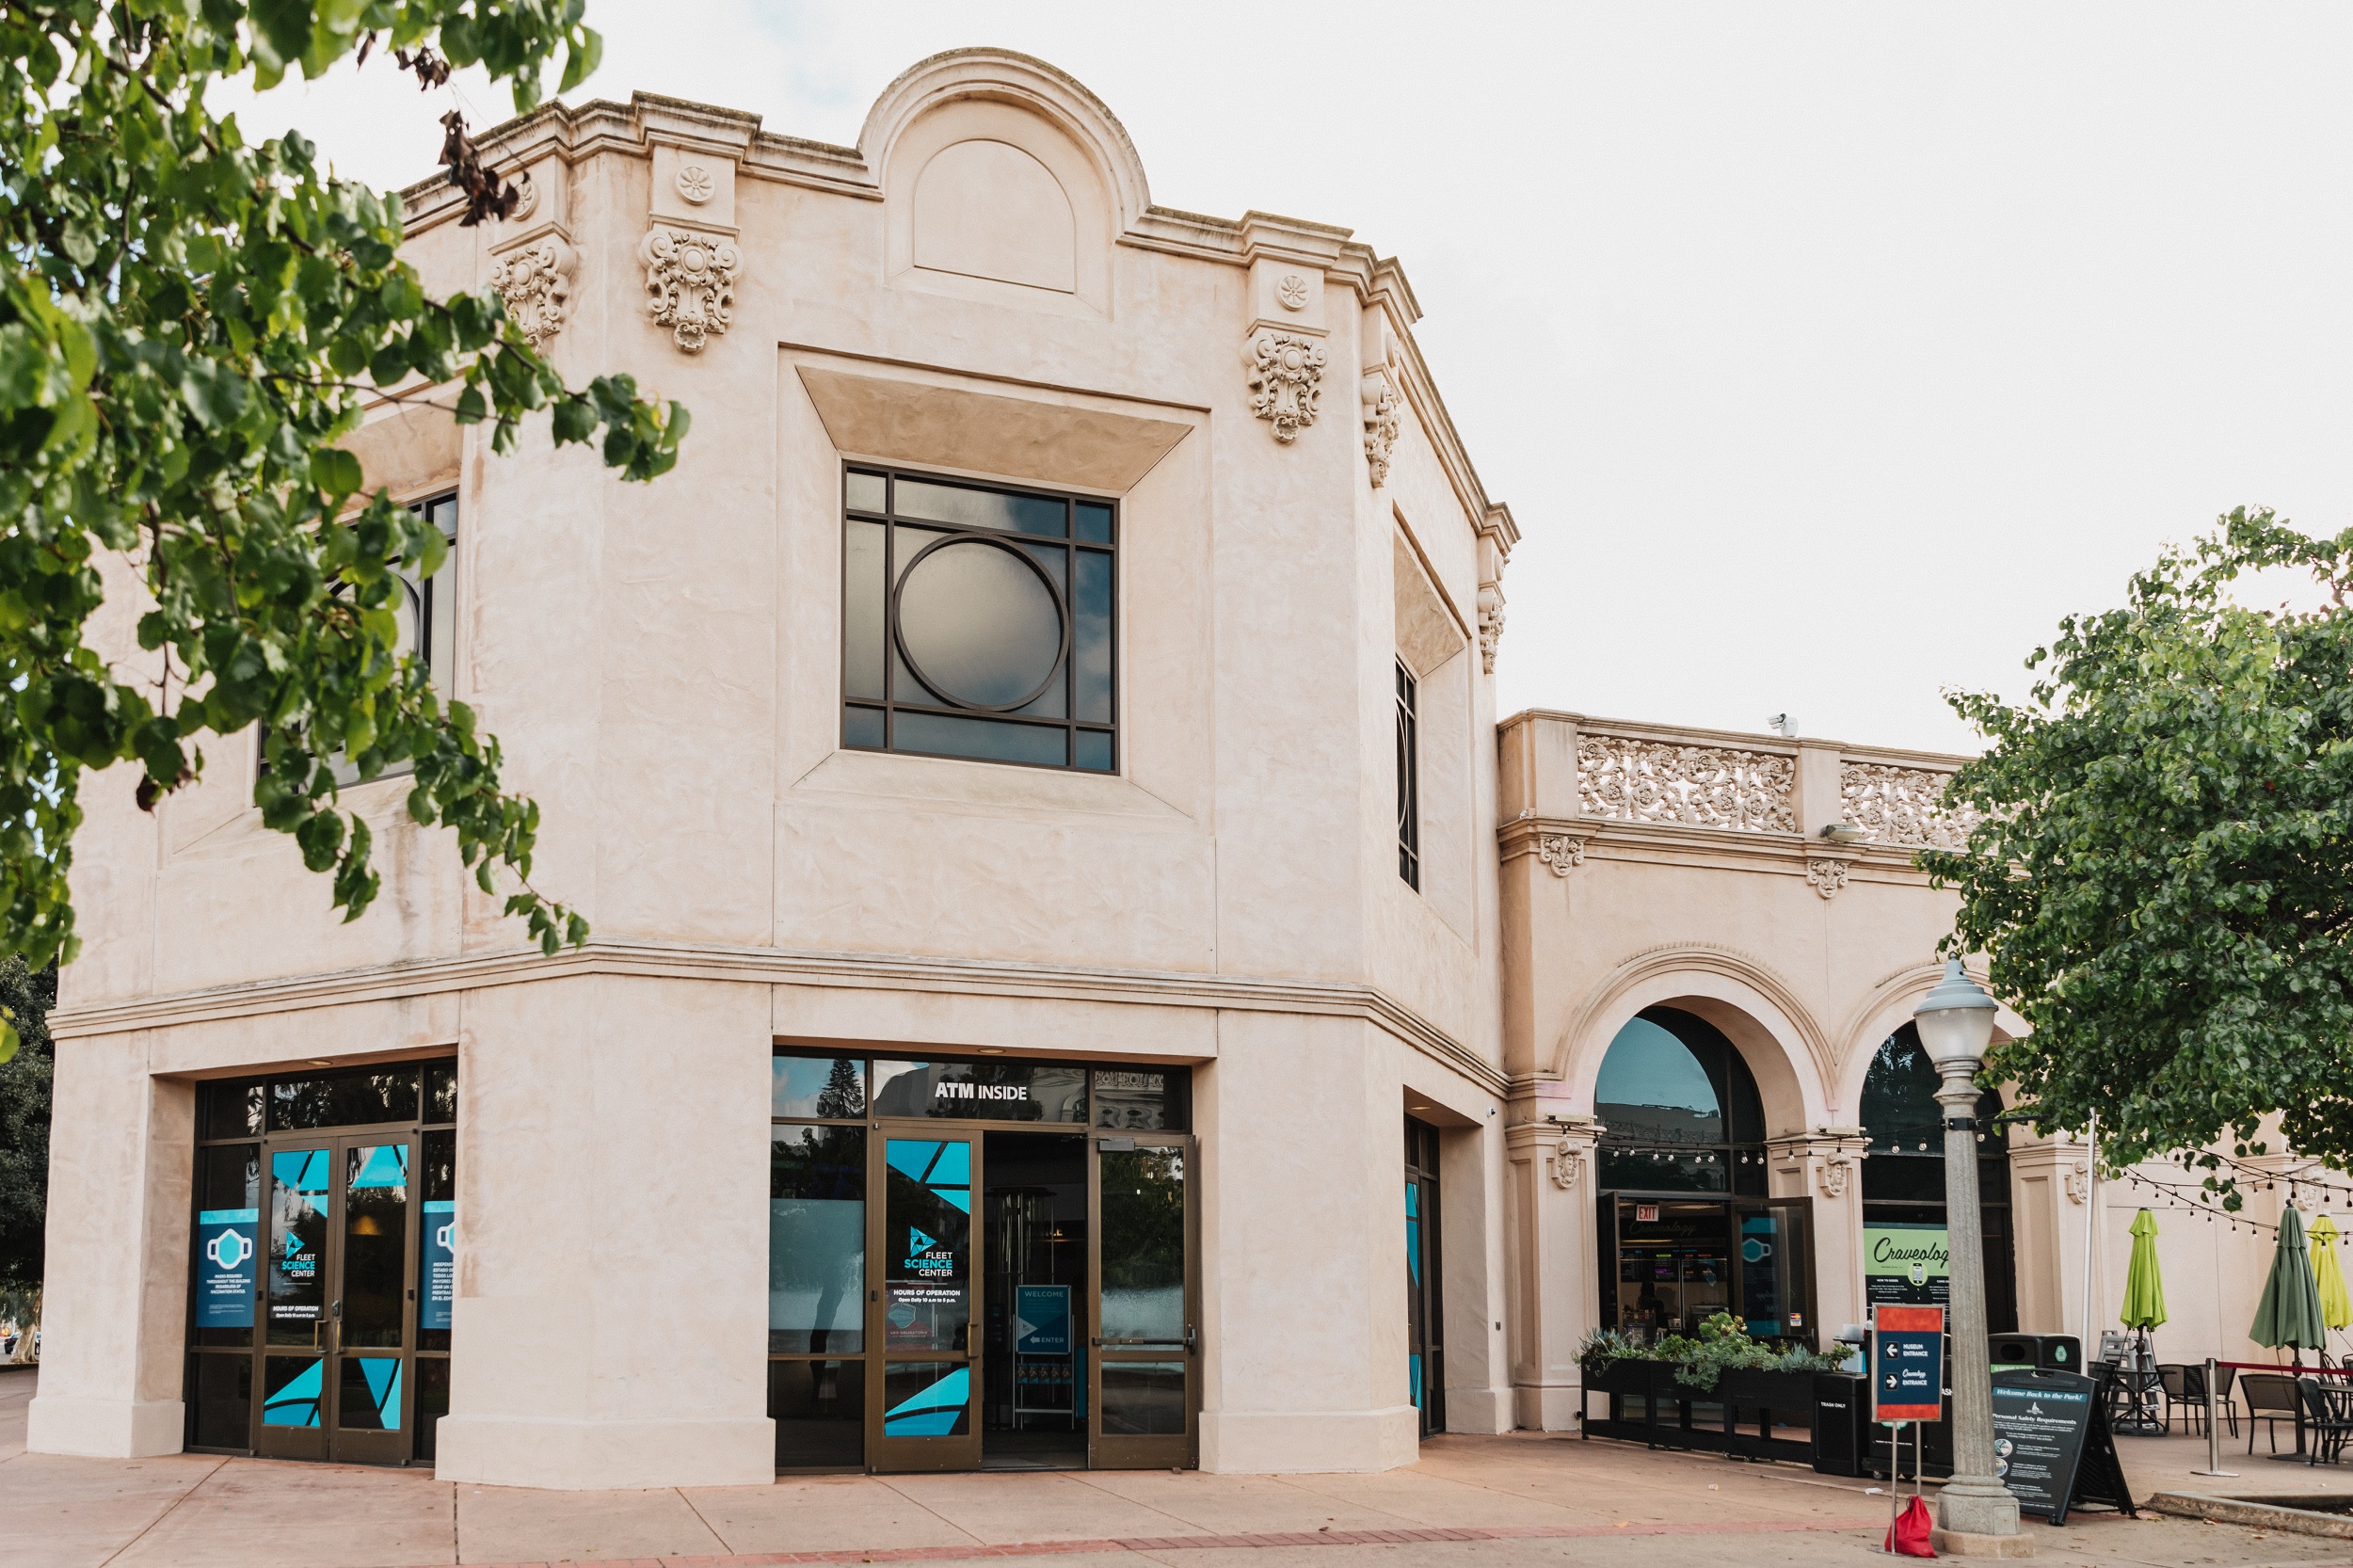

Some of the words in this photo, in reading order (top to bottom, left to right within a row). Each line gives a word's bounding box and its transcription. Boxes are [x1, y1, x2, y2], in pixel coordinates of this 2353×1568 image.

[935, 1081, 974, 1099] ATM
[978, 1085, 1028, 1100] INSIDE
[1638, 1206, 1657, 1220] EXIT
[925, 1251, 952, 1259] FLEET
[1873, 1237, 1949, 1269] Craveolog
[281, 1260, 315, 1271] SCIENCE
[904, 1259, 952, 1269] SCIENCE
[919, 1269, 952, 1277] CENTER
[1024, 1290, 1064, 1299] WELCOME
[1996, 1388, 2026, 1398] Welcome
[1993, 1413, 2017, 1421] Personal
[2017, 1415, 2036, 1423] Safety
[2036, 1416, 2077, 1426] Requirements
